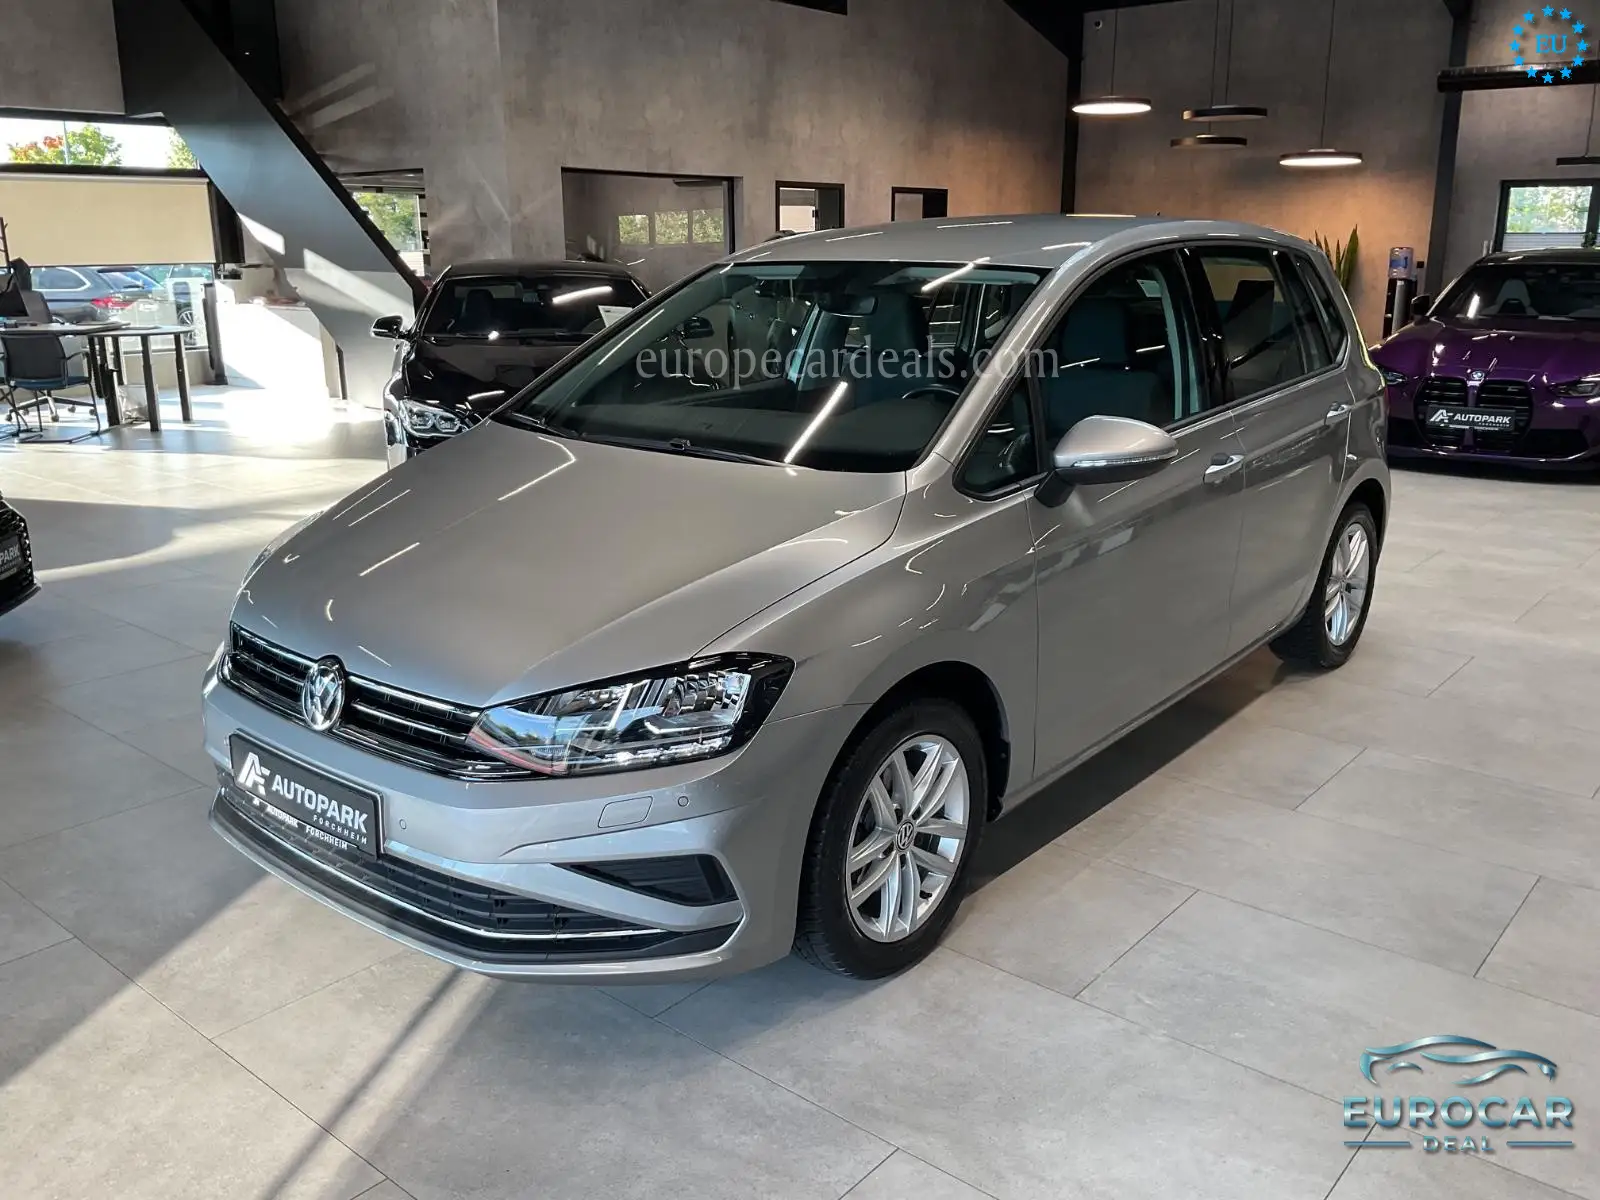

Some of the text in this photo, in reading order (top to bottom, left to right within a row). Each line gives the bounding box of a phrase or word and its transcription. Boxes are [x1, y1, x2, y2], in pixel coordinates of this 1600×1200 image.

[1453, 413, 1511, 424] AUTOPARK
[271, 774, 368, 833] AUTOPARK
[265, 804, 348, 850] AUTOPARK FORCHHEIM
[313, 815, 367, 845] FORCHHEIM
